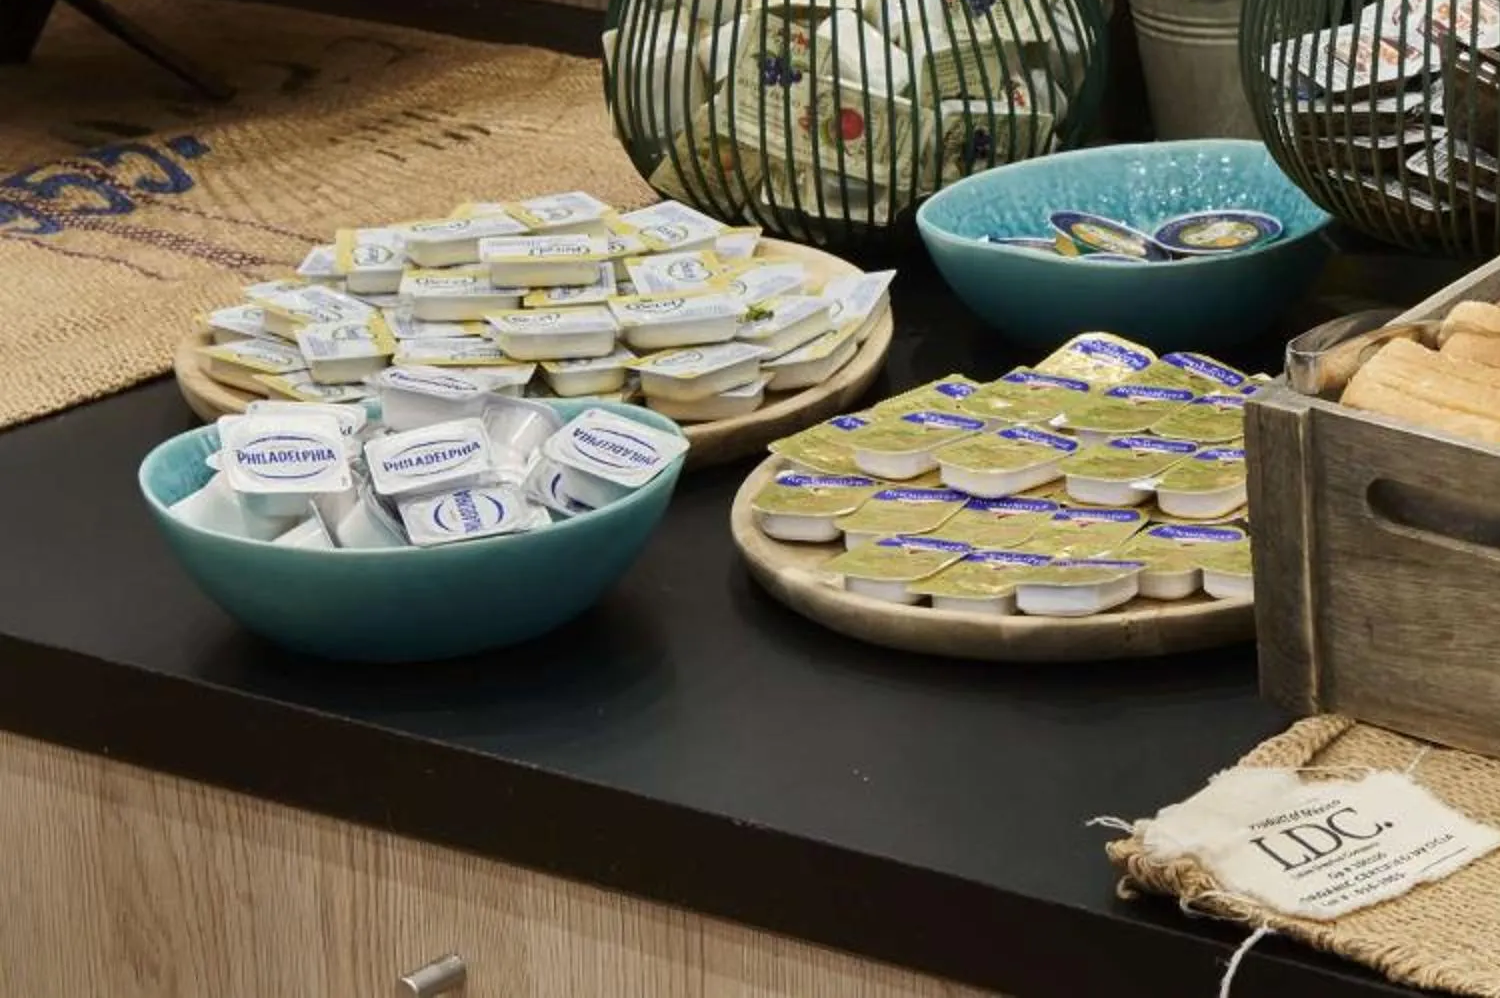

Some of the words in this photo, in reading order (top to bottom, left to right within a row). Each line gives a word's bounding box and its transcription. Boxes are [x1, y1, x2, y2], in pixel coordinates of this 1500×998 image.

[235, 448, 337, 467] PHILADELPHIA
[382, 440, 481, 472] PHILADELPHIA
[1250, 807, 1394, 872] LDC.
